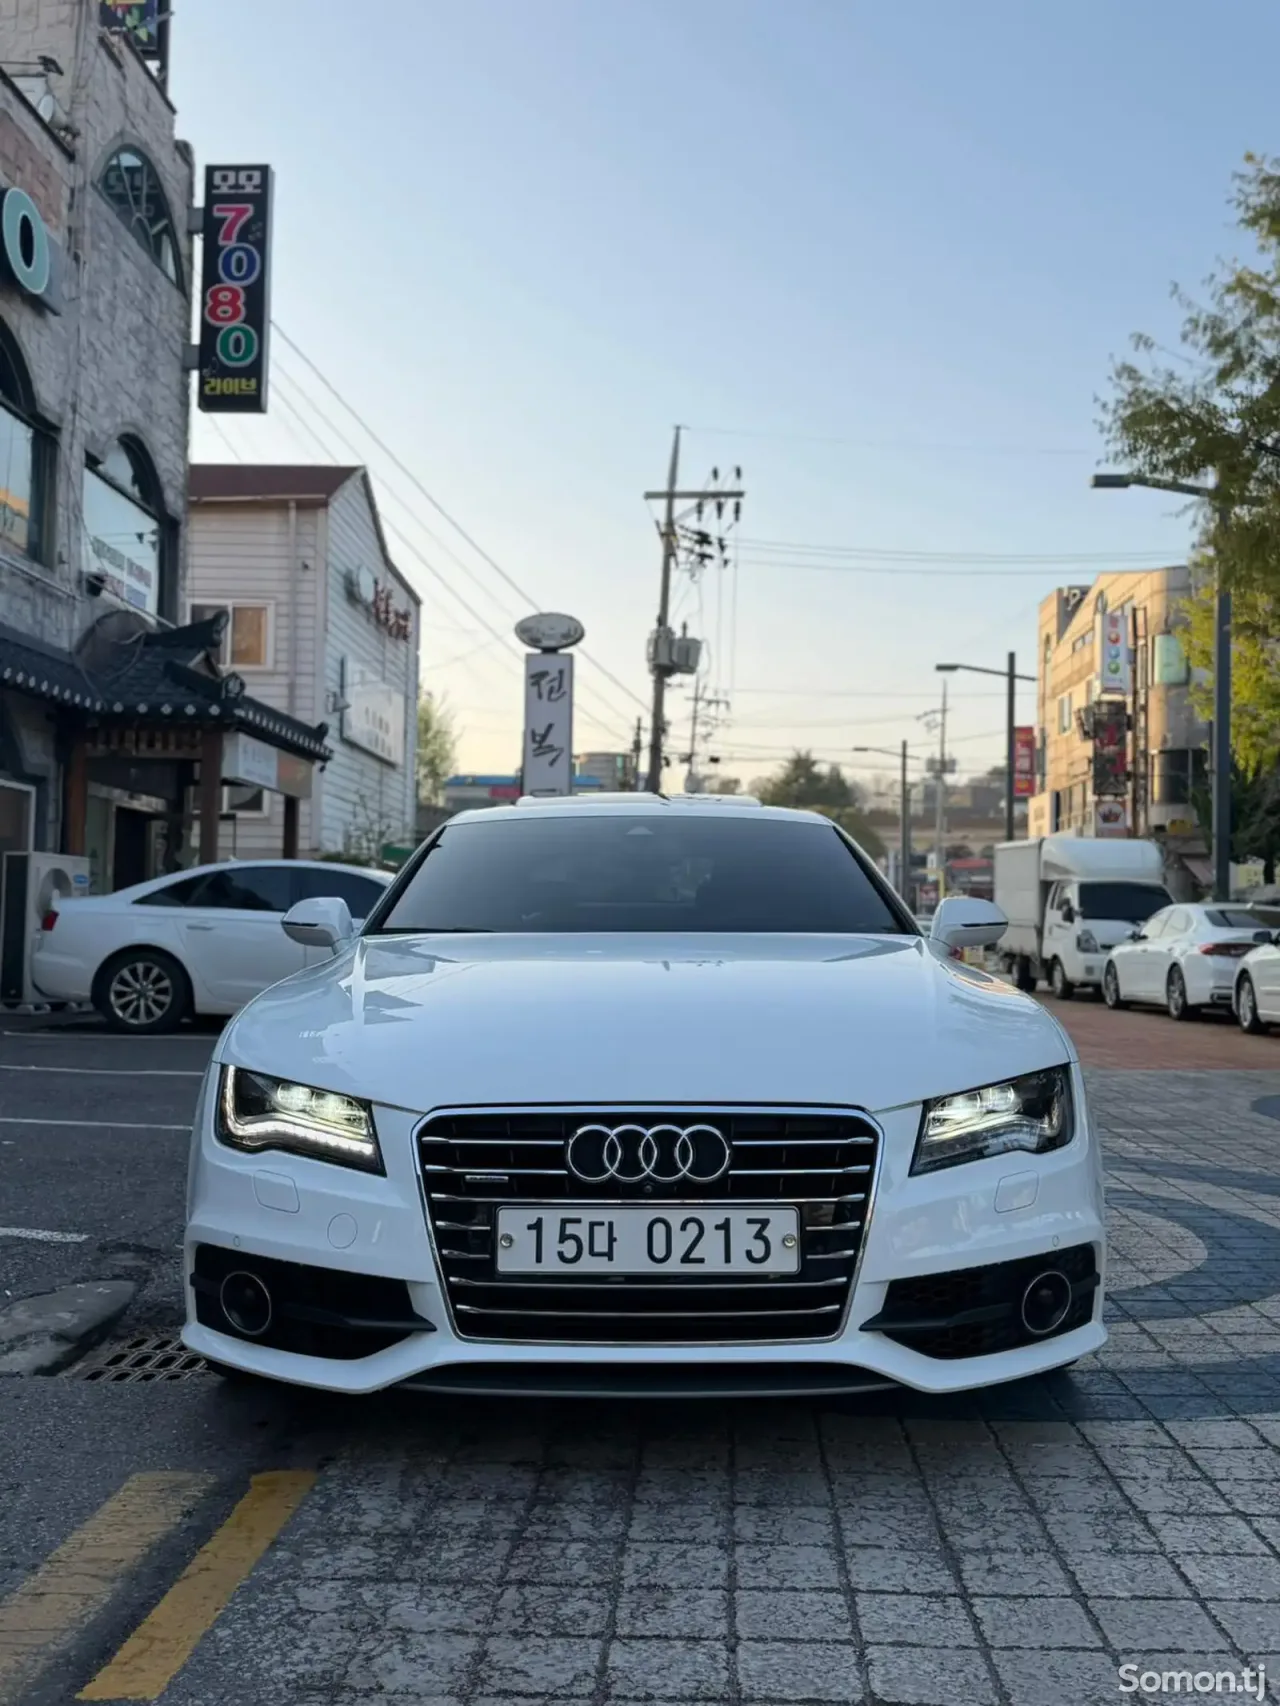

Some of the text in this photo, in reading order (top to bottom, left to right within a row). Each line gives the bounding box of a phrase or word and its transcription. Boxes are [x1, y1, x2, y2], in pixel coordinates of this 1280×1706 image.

[212, 170, 262, 194] 모모
[205, 203, 261, 368] 7080
[204, 377, 257, 395] 라이브
[527, 1217, 772, 1264] 15다 0213
